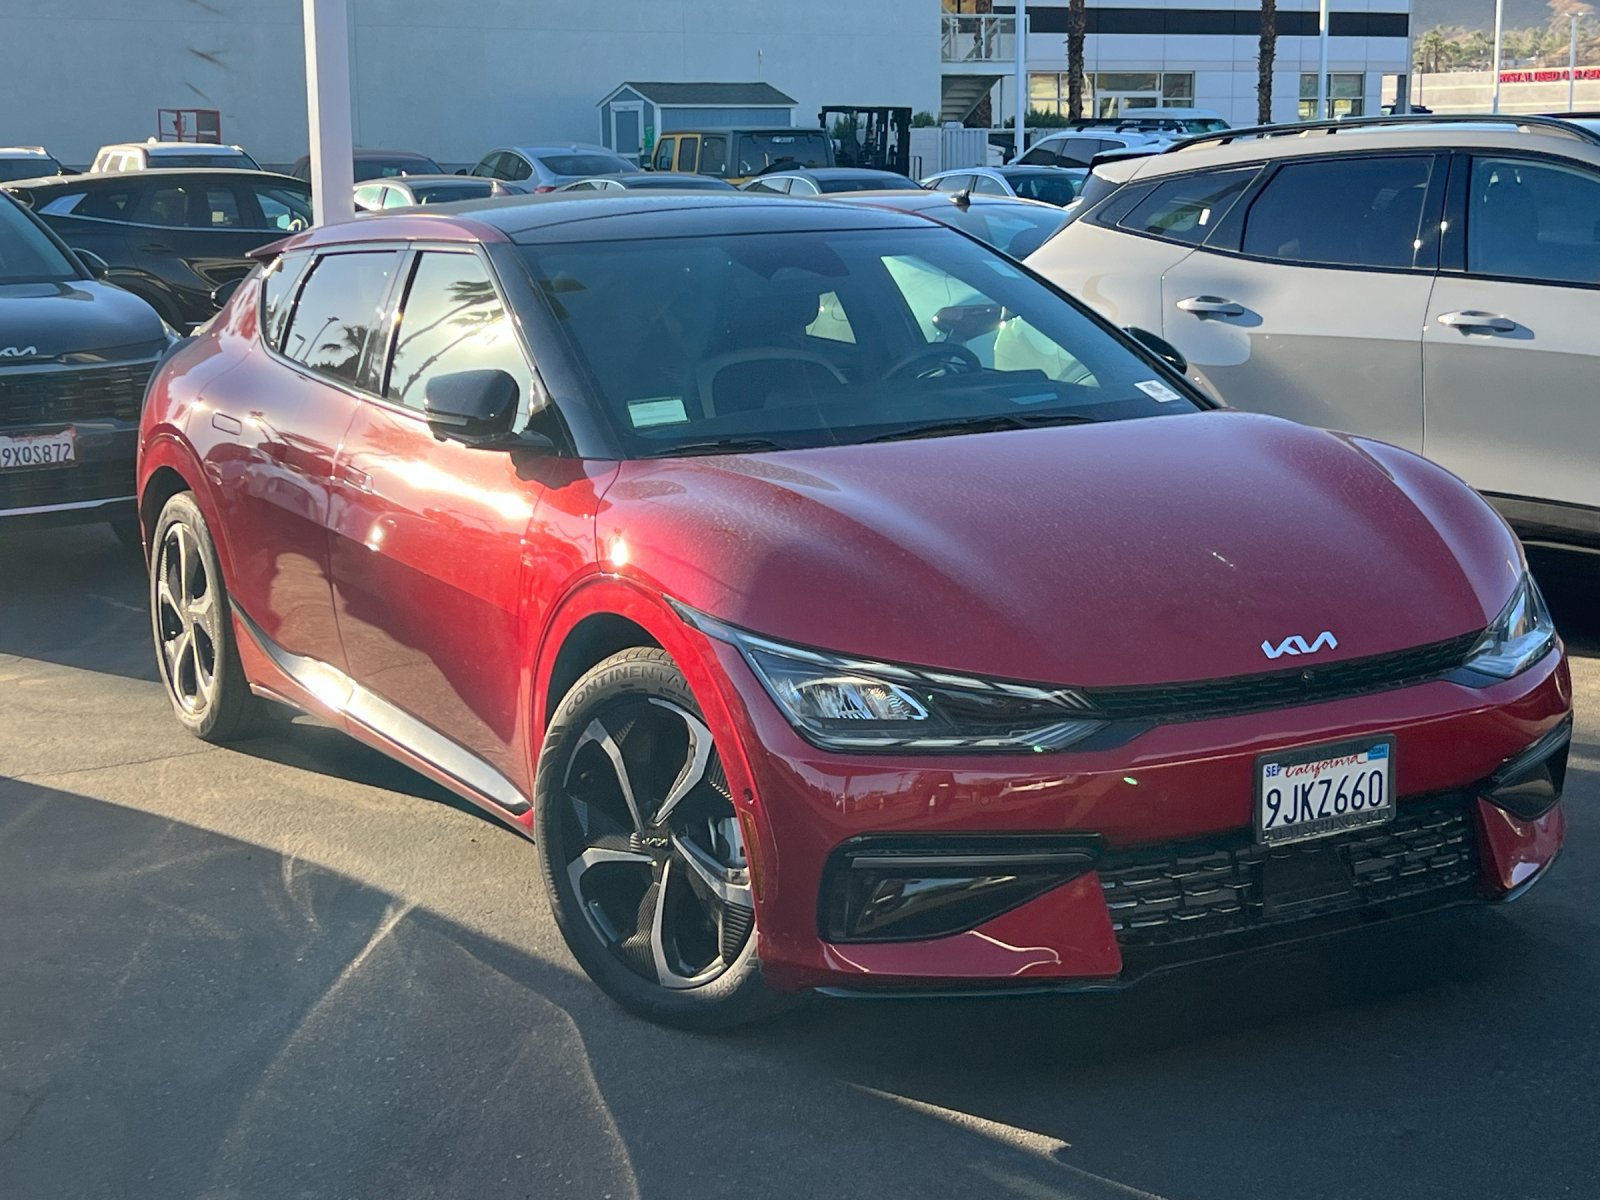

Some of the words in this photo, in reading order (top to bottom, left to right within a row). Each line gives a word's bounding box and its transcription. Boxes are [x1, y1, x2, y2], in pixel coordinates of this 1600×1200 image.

[1535, 71, 1560, 81] USED
[1261, 631, 1338, 659] KIA
[1285, 754, 1367, 778] California
[1266, 770, 1383, 829] 9JKZ660
[1303, 810, 1361, 836] SPRINGS
